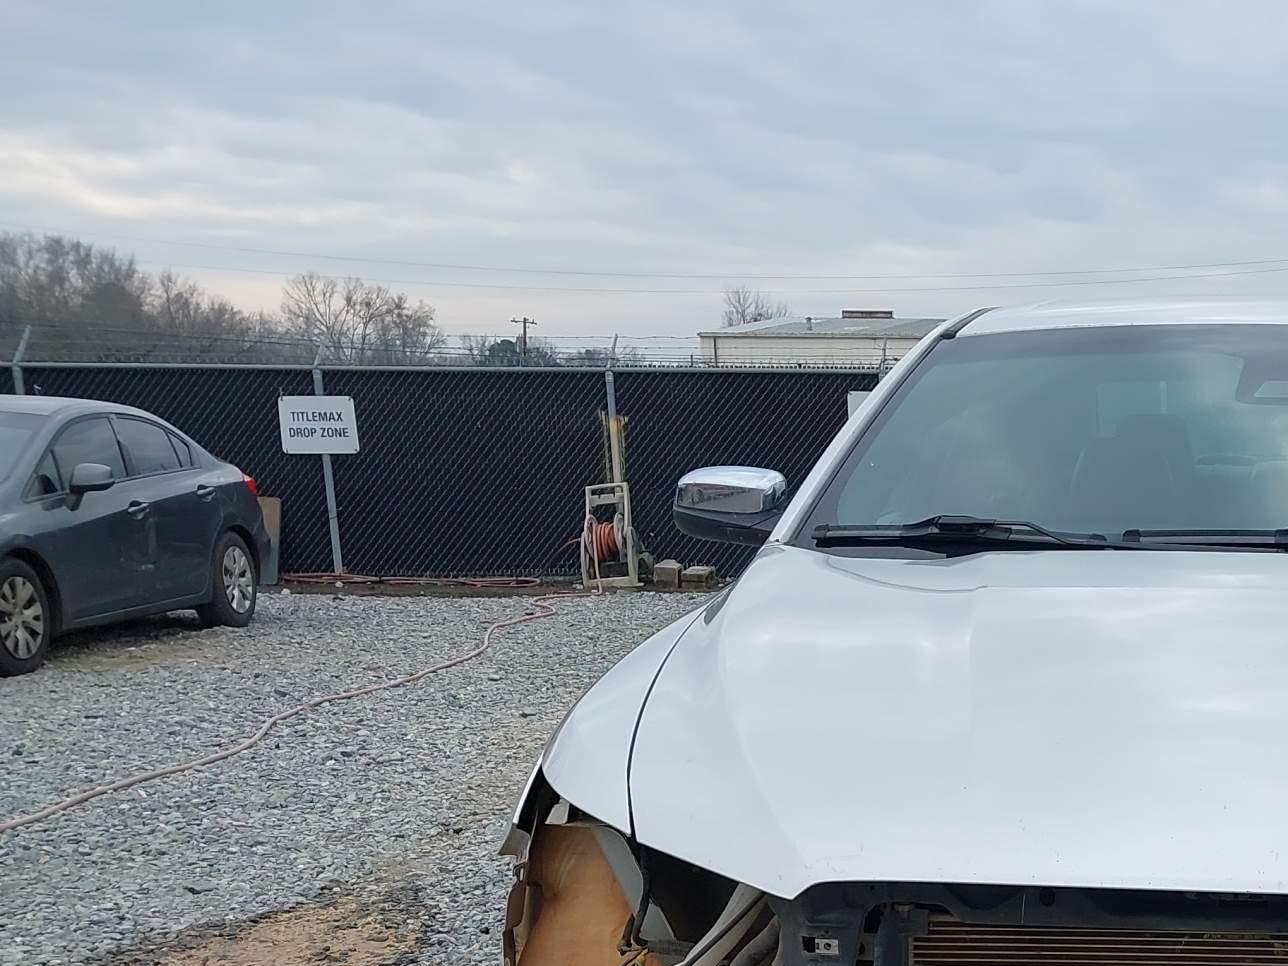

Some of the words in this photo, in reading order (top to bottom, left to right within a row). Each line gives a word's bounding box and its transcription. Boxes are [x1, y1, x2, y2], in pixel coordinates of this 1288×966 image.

[290, 411, 344, 422] TITLEMAX
[288, 427, 317, 438] DROP
[319, 427, 350, 438] ZONE
